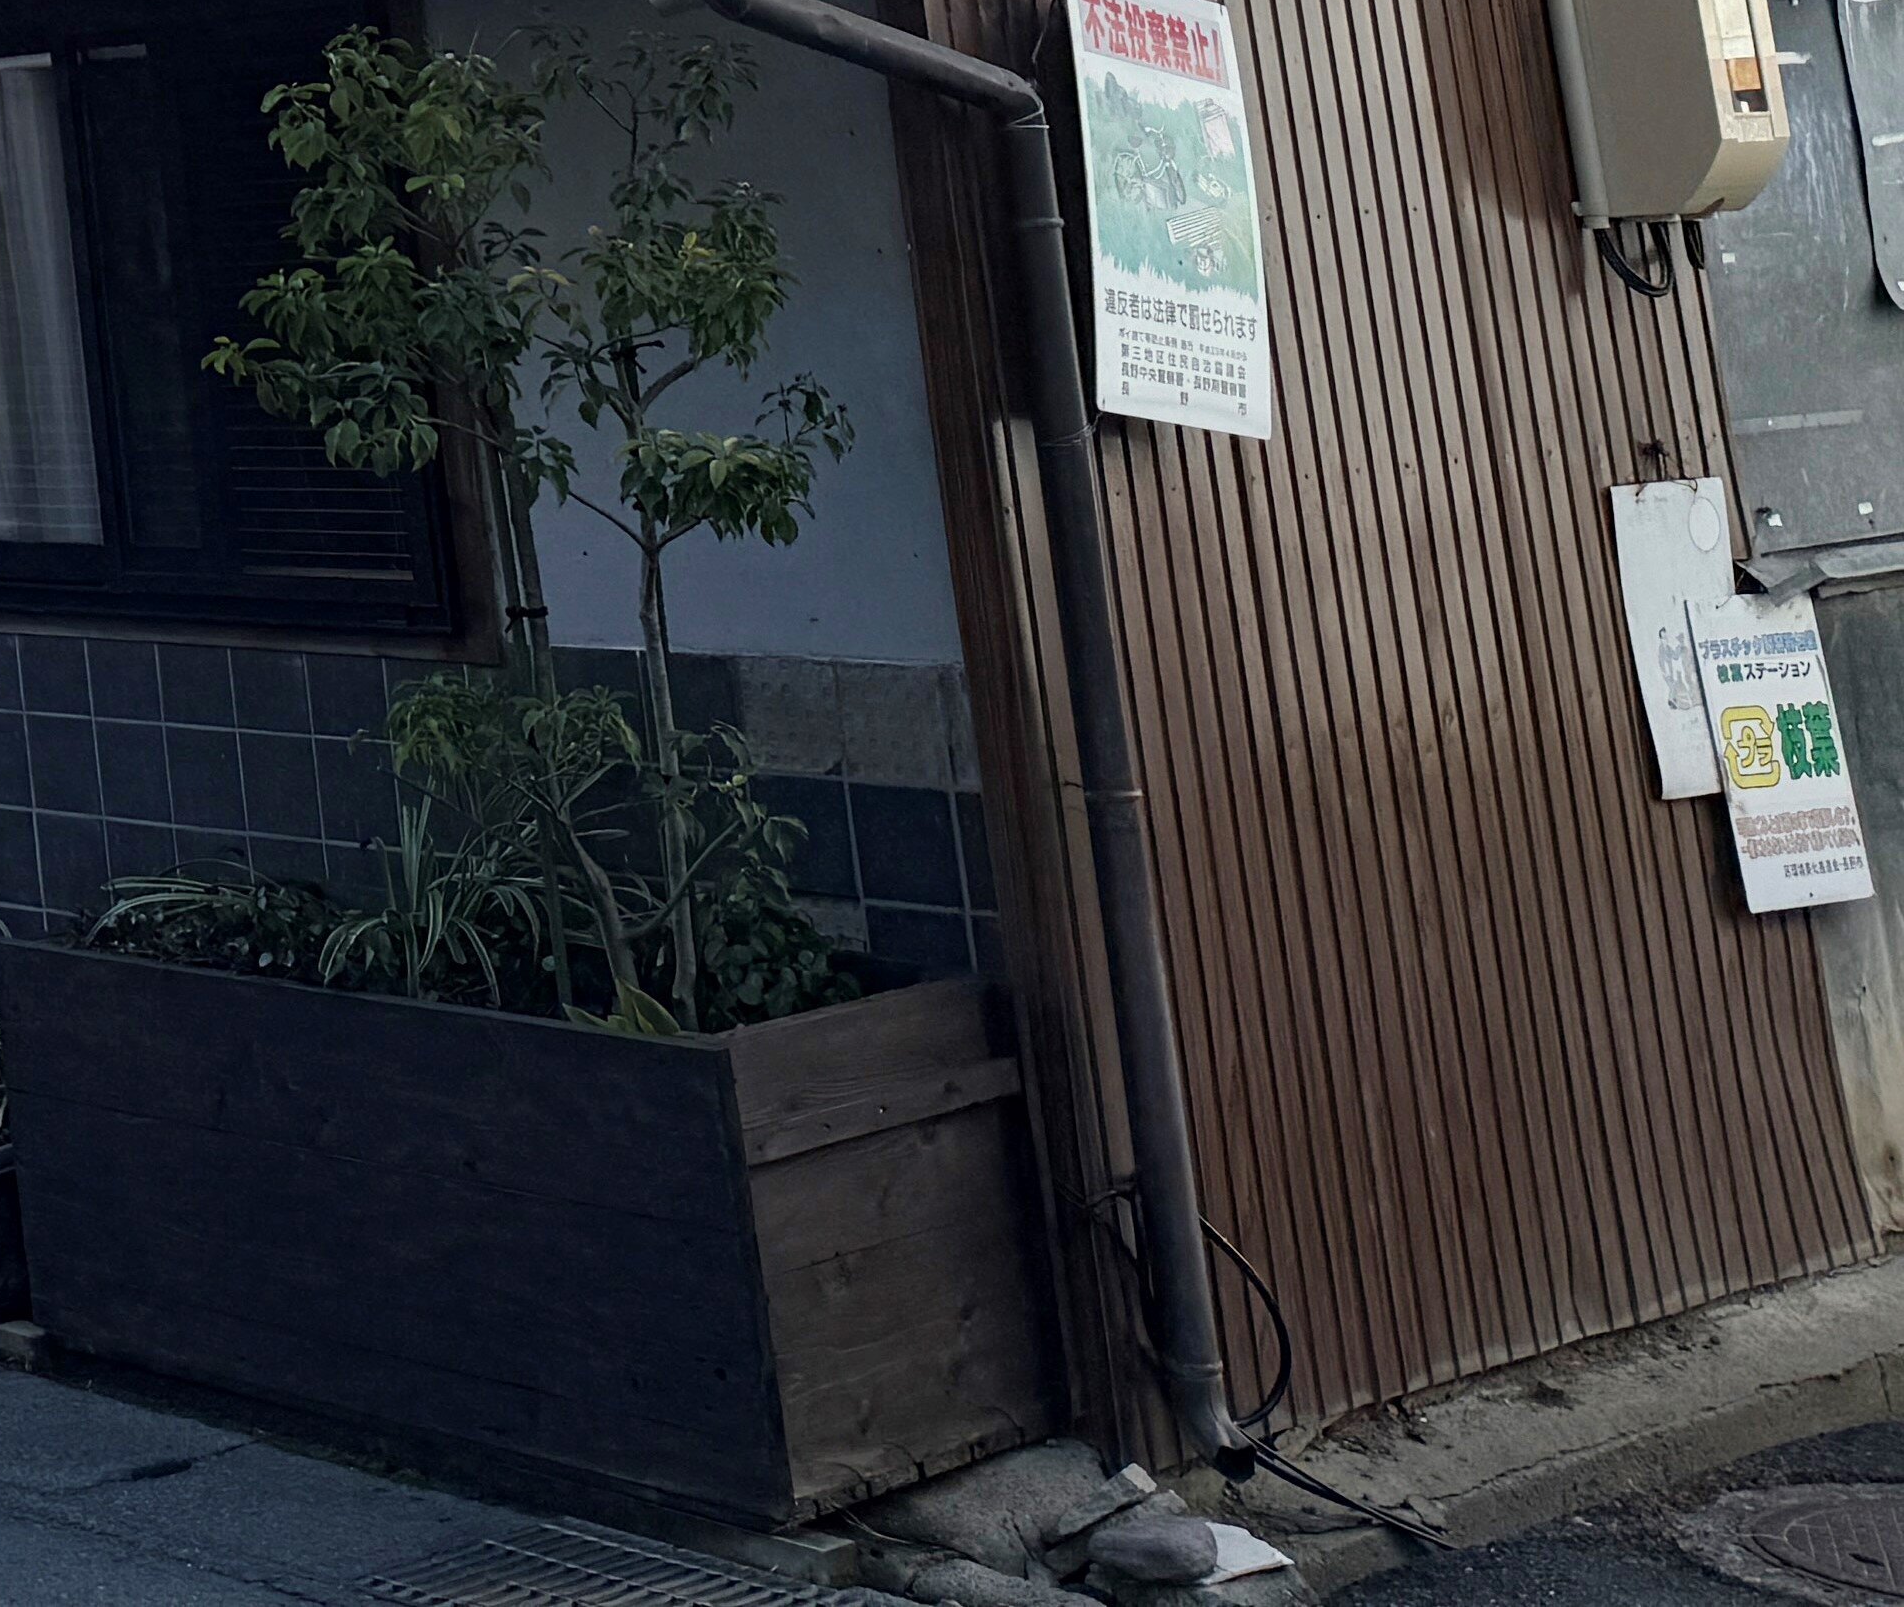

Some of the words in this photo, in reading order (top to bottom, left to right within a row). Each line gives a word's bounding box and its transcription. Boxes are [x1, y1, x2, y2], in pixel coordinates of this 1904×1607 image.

[1105, 286, 1258, 341] 違反者は法律で罰せられます
[1121, 343, 1246, 380] 第三地区住民自治協議会
[1716, 661, 1811, 684] 枝葉ステーション
[1776, 701, 1840, 780] 枝葉
